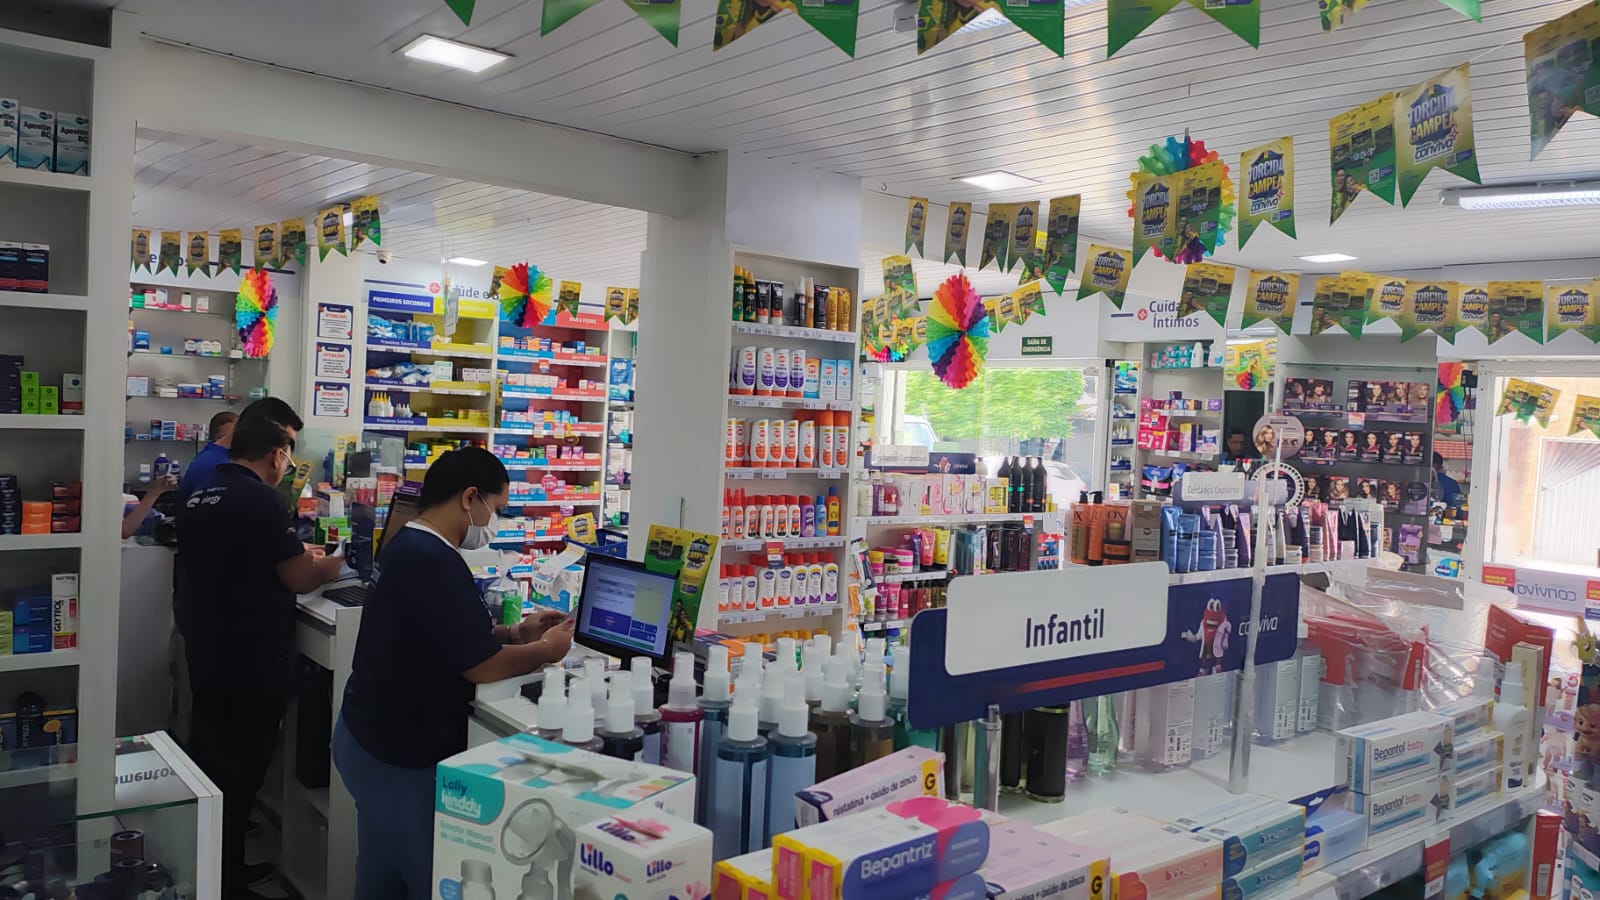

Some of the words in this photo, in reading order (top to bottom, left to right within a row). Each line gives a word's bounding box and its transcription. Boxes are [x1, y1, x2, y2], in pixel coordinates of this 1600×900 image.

[0, 113, 15, 121] vitin
[1408, 95, 1457, 126] TORCIDA
[24, 121, 52, 131] Apevitin
[1415, 137, 1453, 160] convivo
[1248, 158, 1285, 184] TORCIDA
[1251, 197, 1278, 211] convivo
[1094, 254, 1125, 268] TORCIDA
[1256, 281, 1289, 293] TORCIDA
[373, 297, 402, 305] PRIMEIROS
[1150, 300, 1181, 313] Cuida
[1414, 291, 1449, 303] TORCIDA
[1153, 315, 1199, 329] Íntimos
[1025, 609, 1104, 649] Infantil
[1238, 614, 1278, 636] covivo
[1374, 740, 1405, 761] Bepantol
[1407, 739, 1424, 752] baby
[442, 775, 468, 794] Lolly
[925, 773, 936, 791] G
[441, 791, 481, 813] kinddy
[833, 797, 864, 816] nistatina
[870, 786, 889, 801] óxido
[890, 780, 898, 791] de
[899, 774, 917, 788] zinco
[1373, 795, 1405, 816] Bepantol
[597, 822, 635, 842] Lillo
[580, 843, 614, 876] Lillo
[646, 860, 673, 877] Lillo
[860, 840, 934, 880] Bepantriz
[1091, 875, 1102, 894] G
